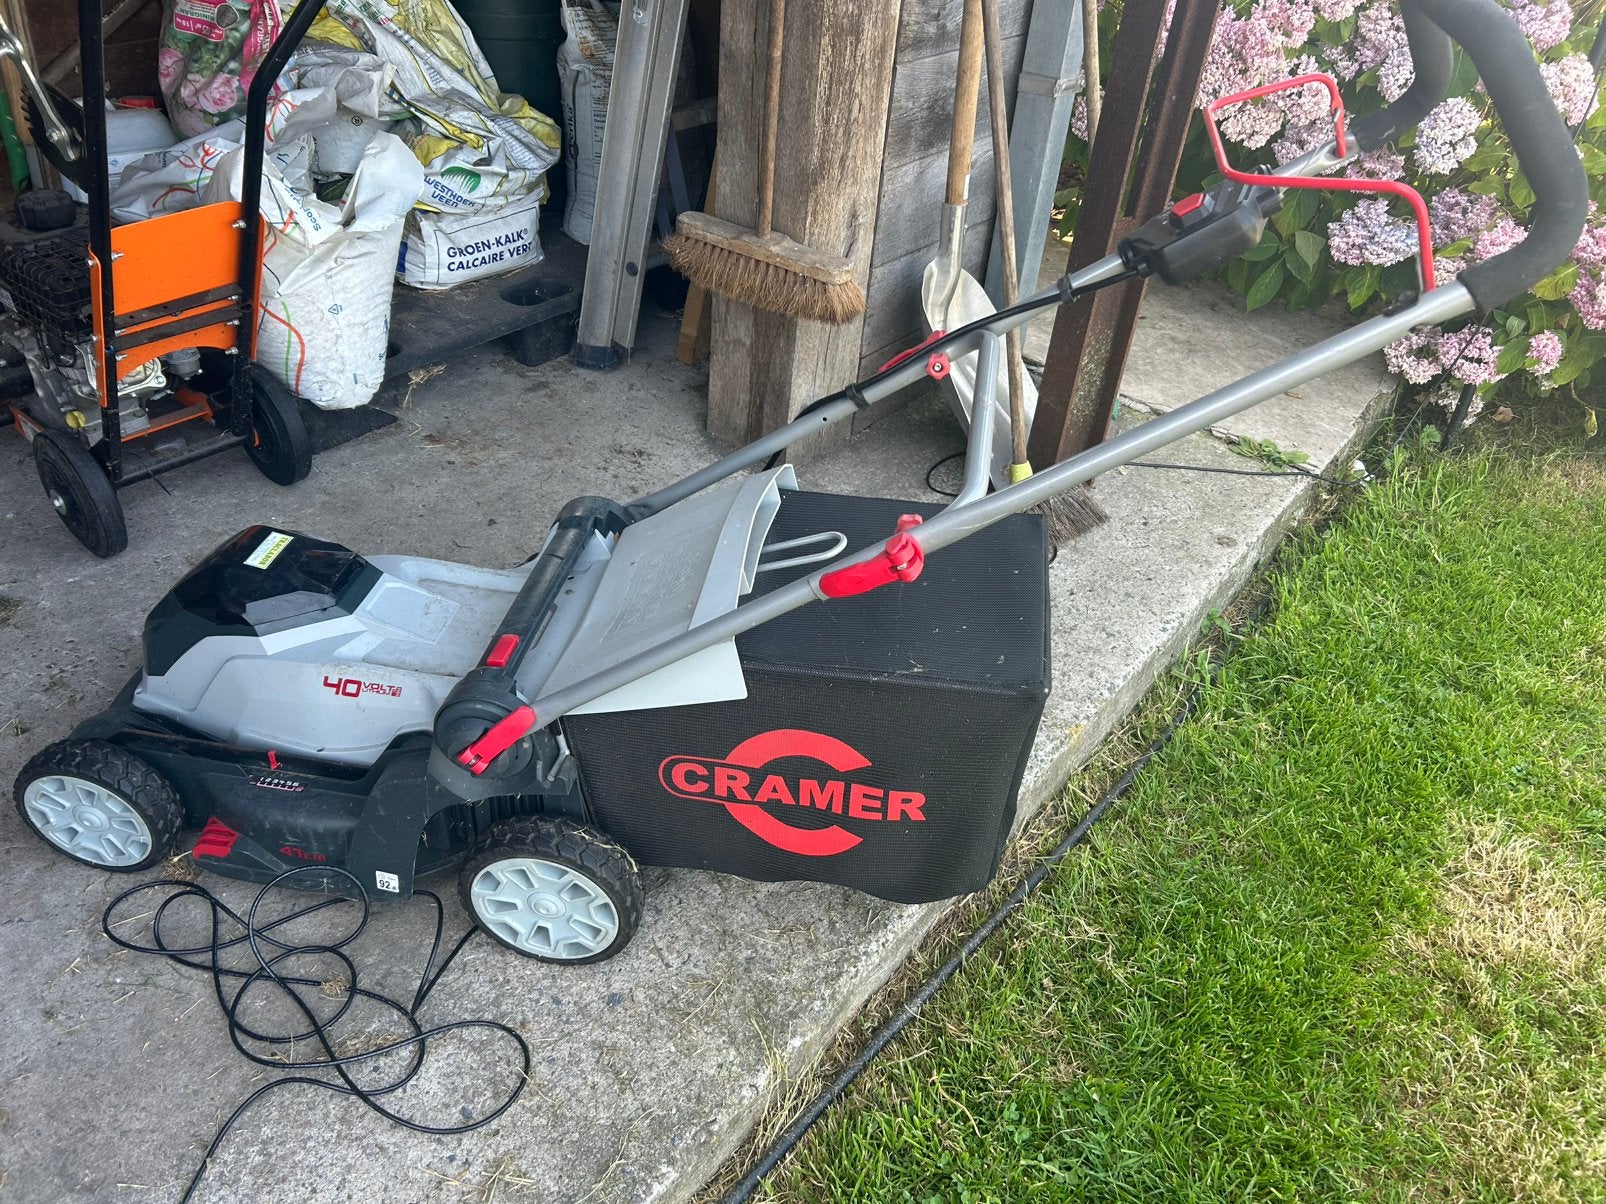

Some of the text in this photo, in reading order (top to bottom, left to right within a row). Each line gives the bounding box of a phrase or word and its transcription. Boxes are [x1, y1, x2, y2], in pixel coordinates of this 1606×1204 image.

[431, 191, 459, 208] VEEN
[447, 242, 532, 272] CALCAIRE VERT
[323, 675, 362, 698] 40
[671, 762, 926, 821] CRAMER
[379, 879, 391, 890] 92
